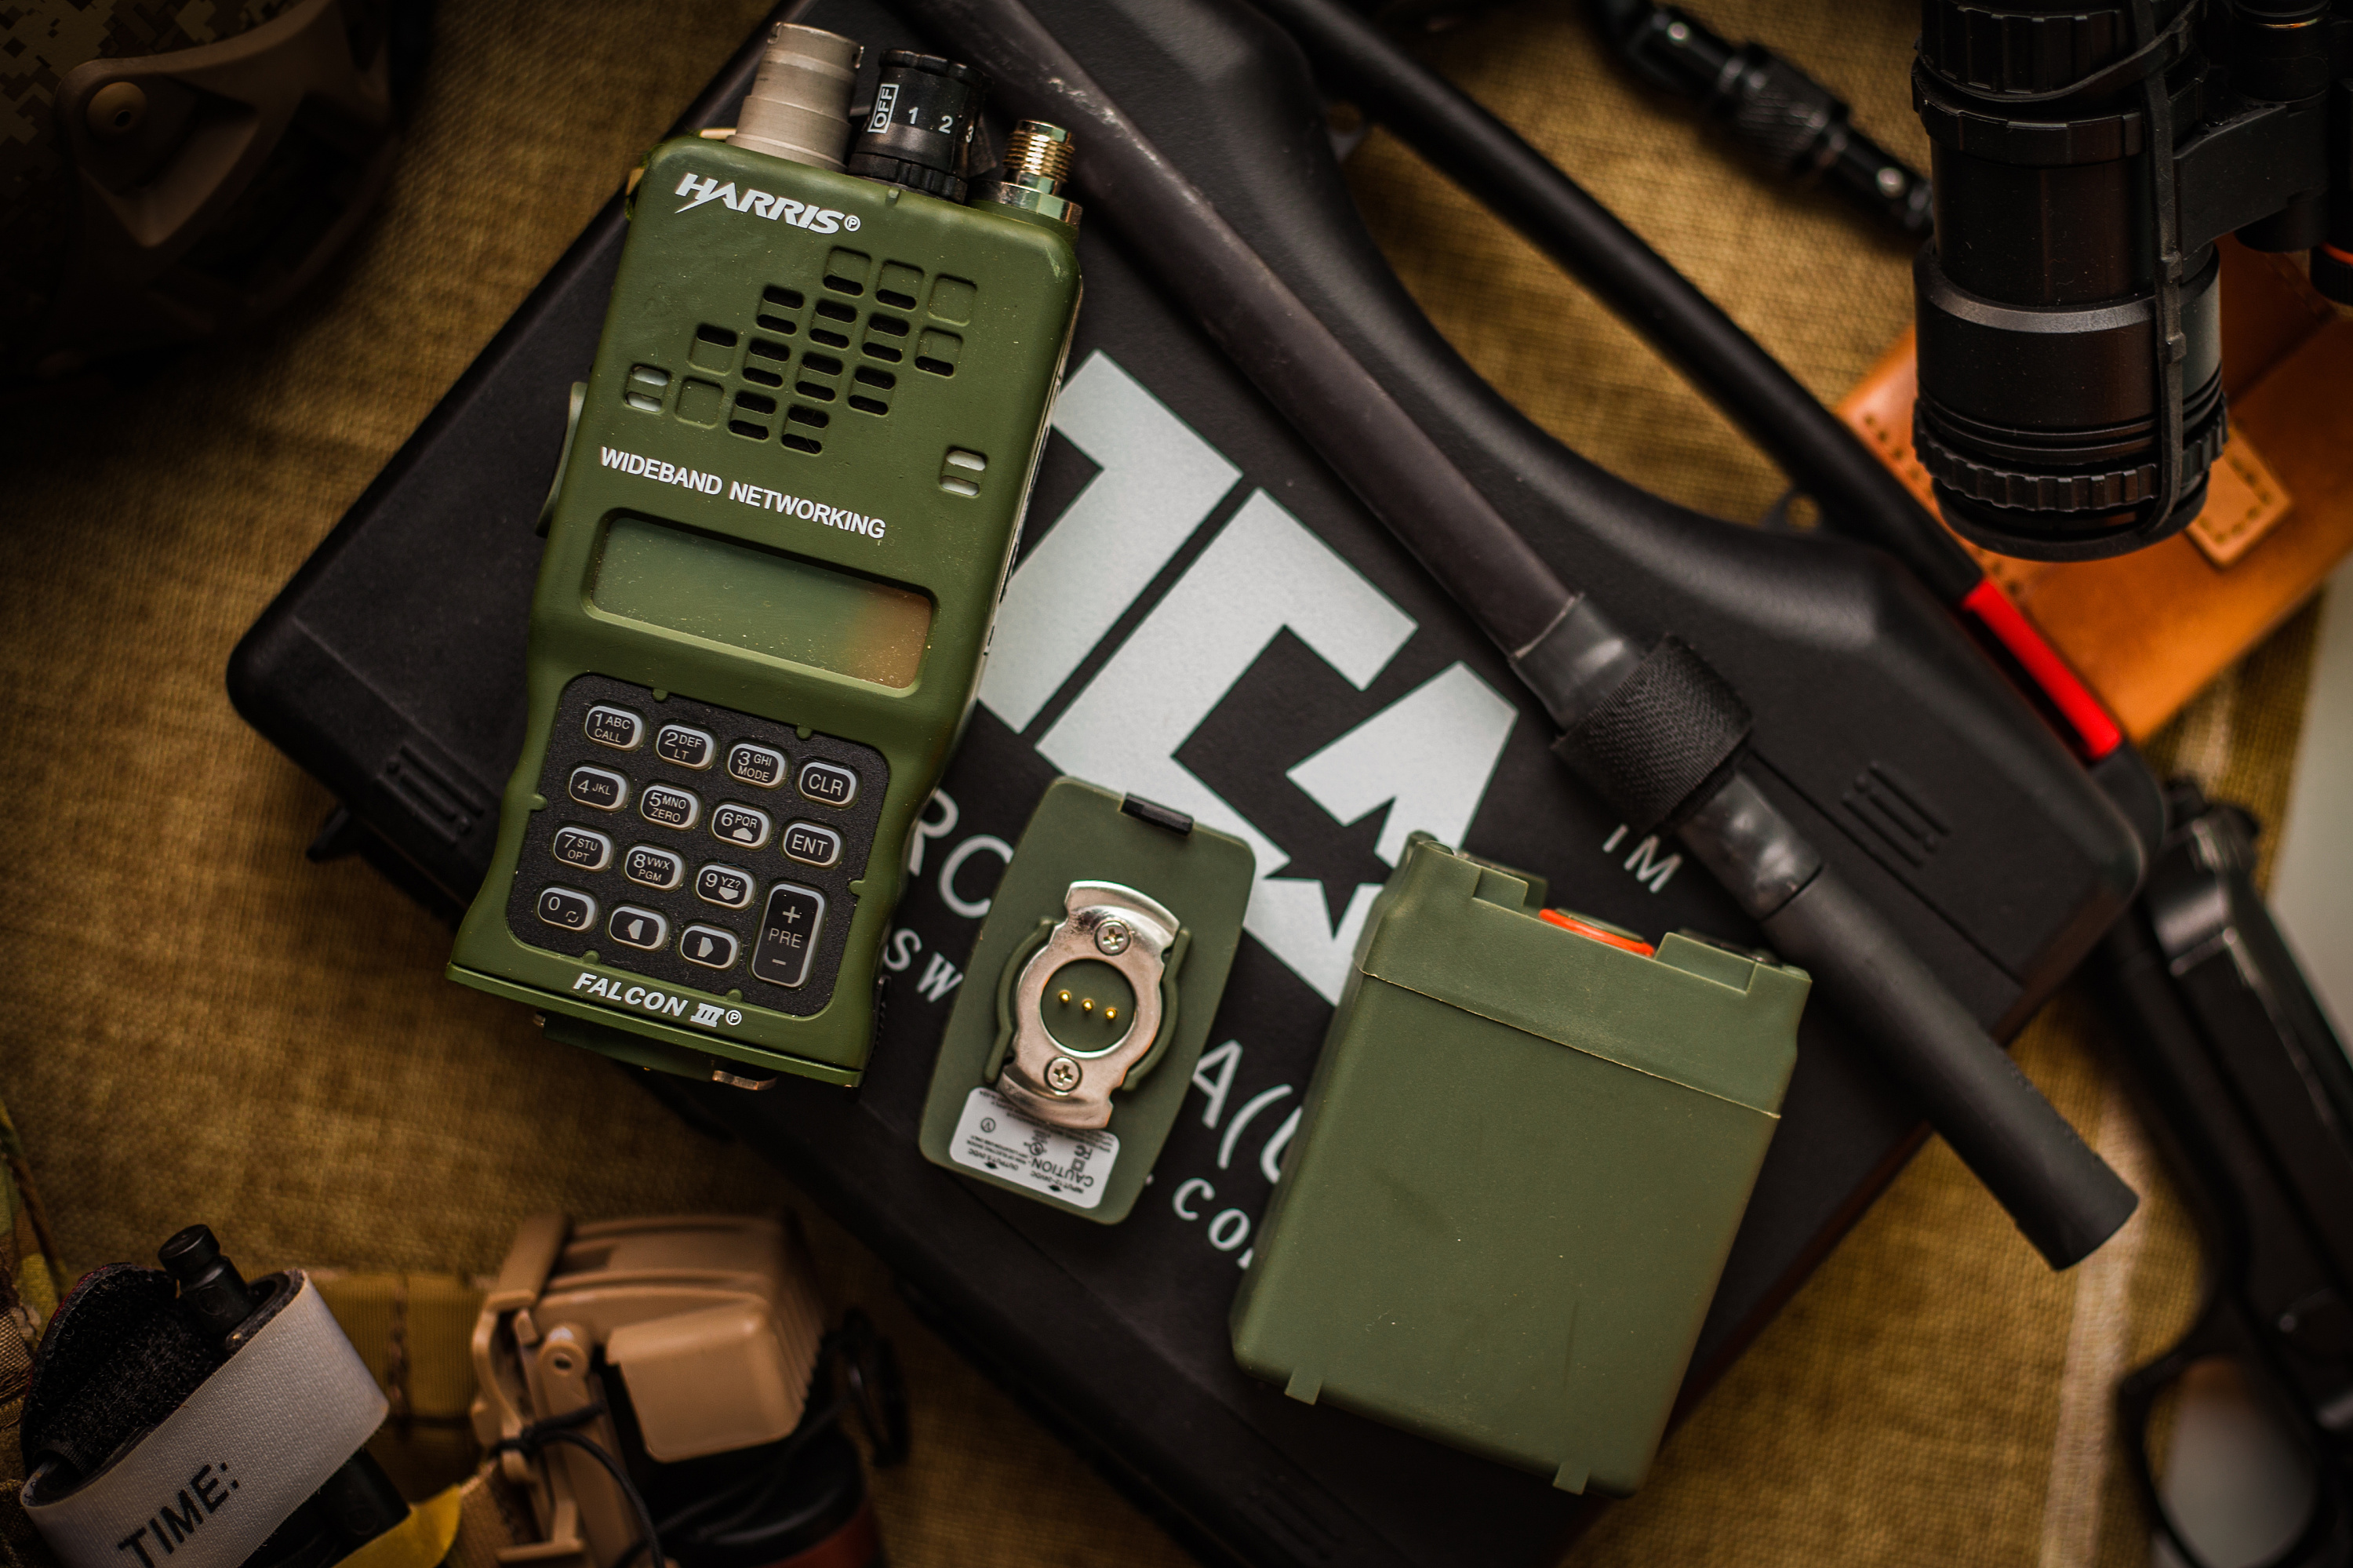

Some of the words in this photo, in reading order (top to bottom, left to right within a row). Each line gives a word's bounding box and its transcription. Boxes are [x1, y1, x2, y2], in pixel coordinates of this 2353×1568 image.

[873, 87, 893, 128] OFF
[908, 107, 918, 125] 1
[938, 115, 954, 134] 2
[966, 125, 974, 144] 3
[600, 446, 722, 495] WIDEBAND
[729, 481, 886, 539] NETWORKING
[594, 728, 621, 744] CALL
[673, 748, 689, 760] LT
[737, 766, 770, 782] MODE
[809, 773, 844, 796] CLR
[650, 807, 681, 823] ZERO
[567, 849, 590, 862] OPT
[791, 834, 828, 856] ENT
[638, 869, 662, 882] PGM
[768, 927, 803, 949] PRE
[573, 972, 689, 1017] FALCON
[117, 1461, 239, 1568] TIME:
